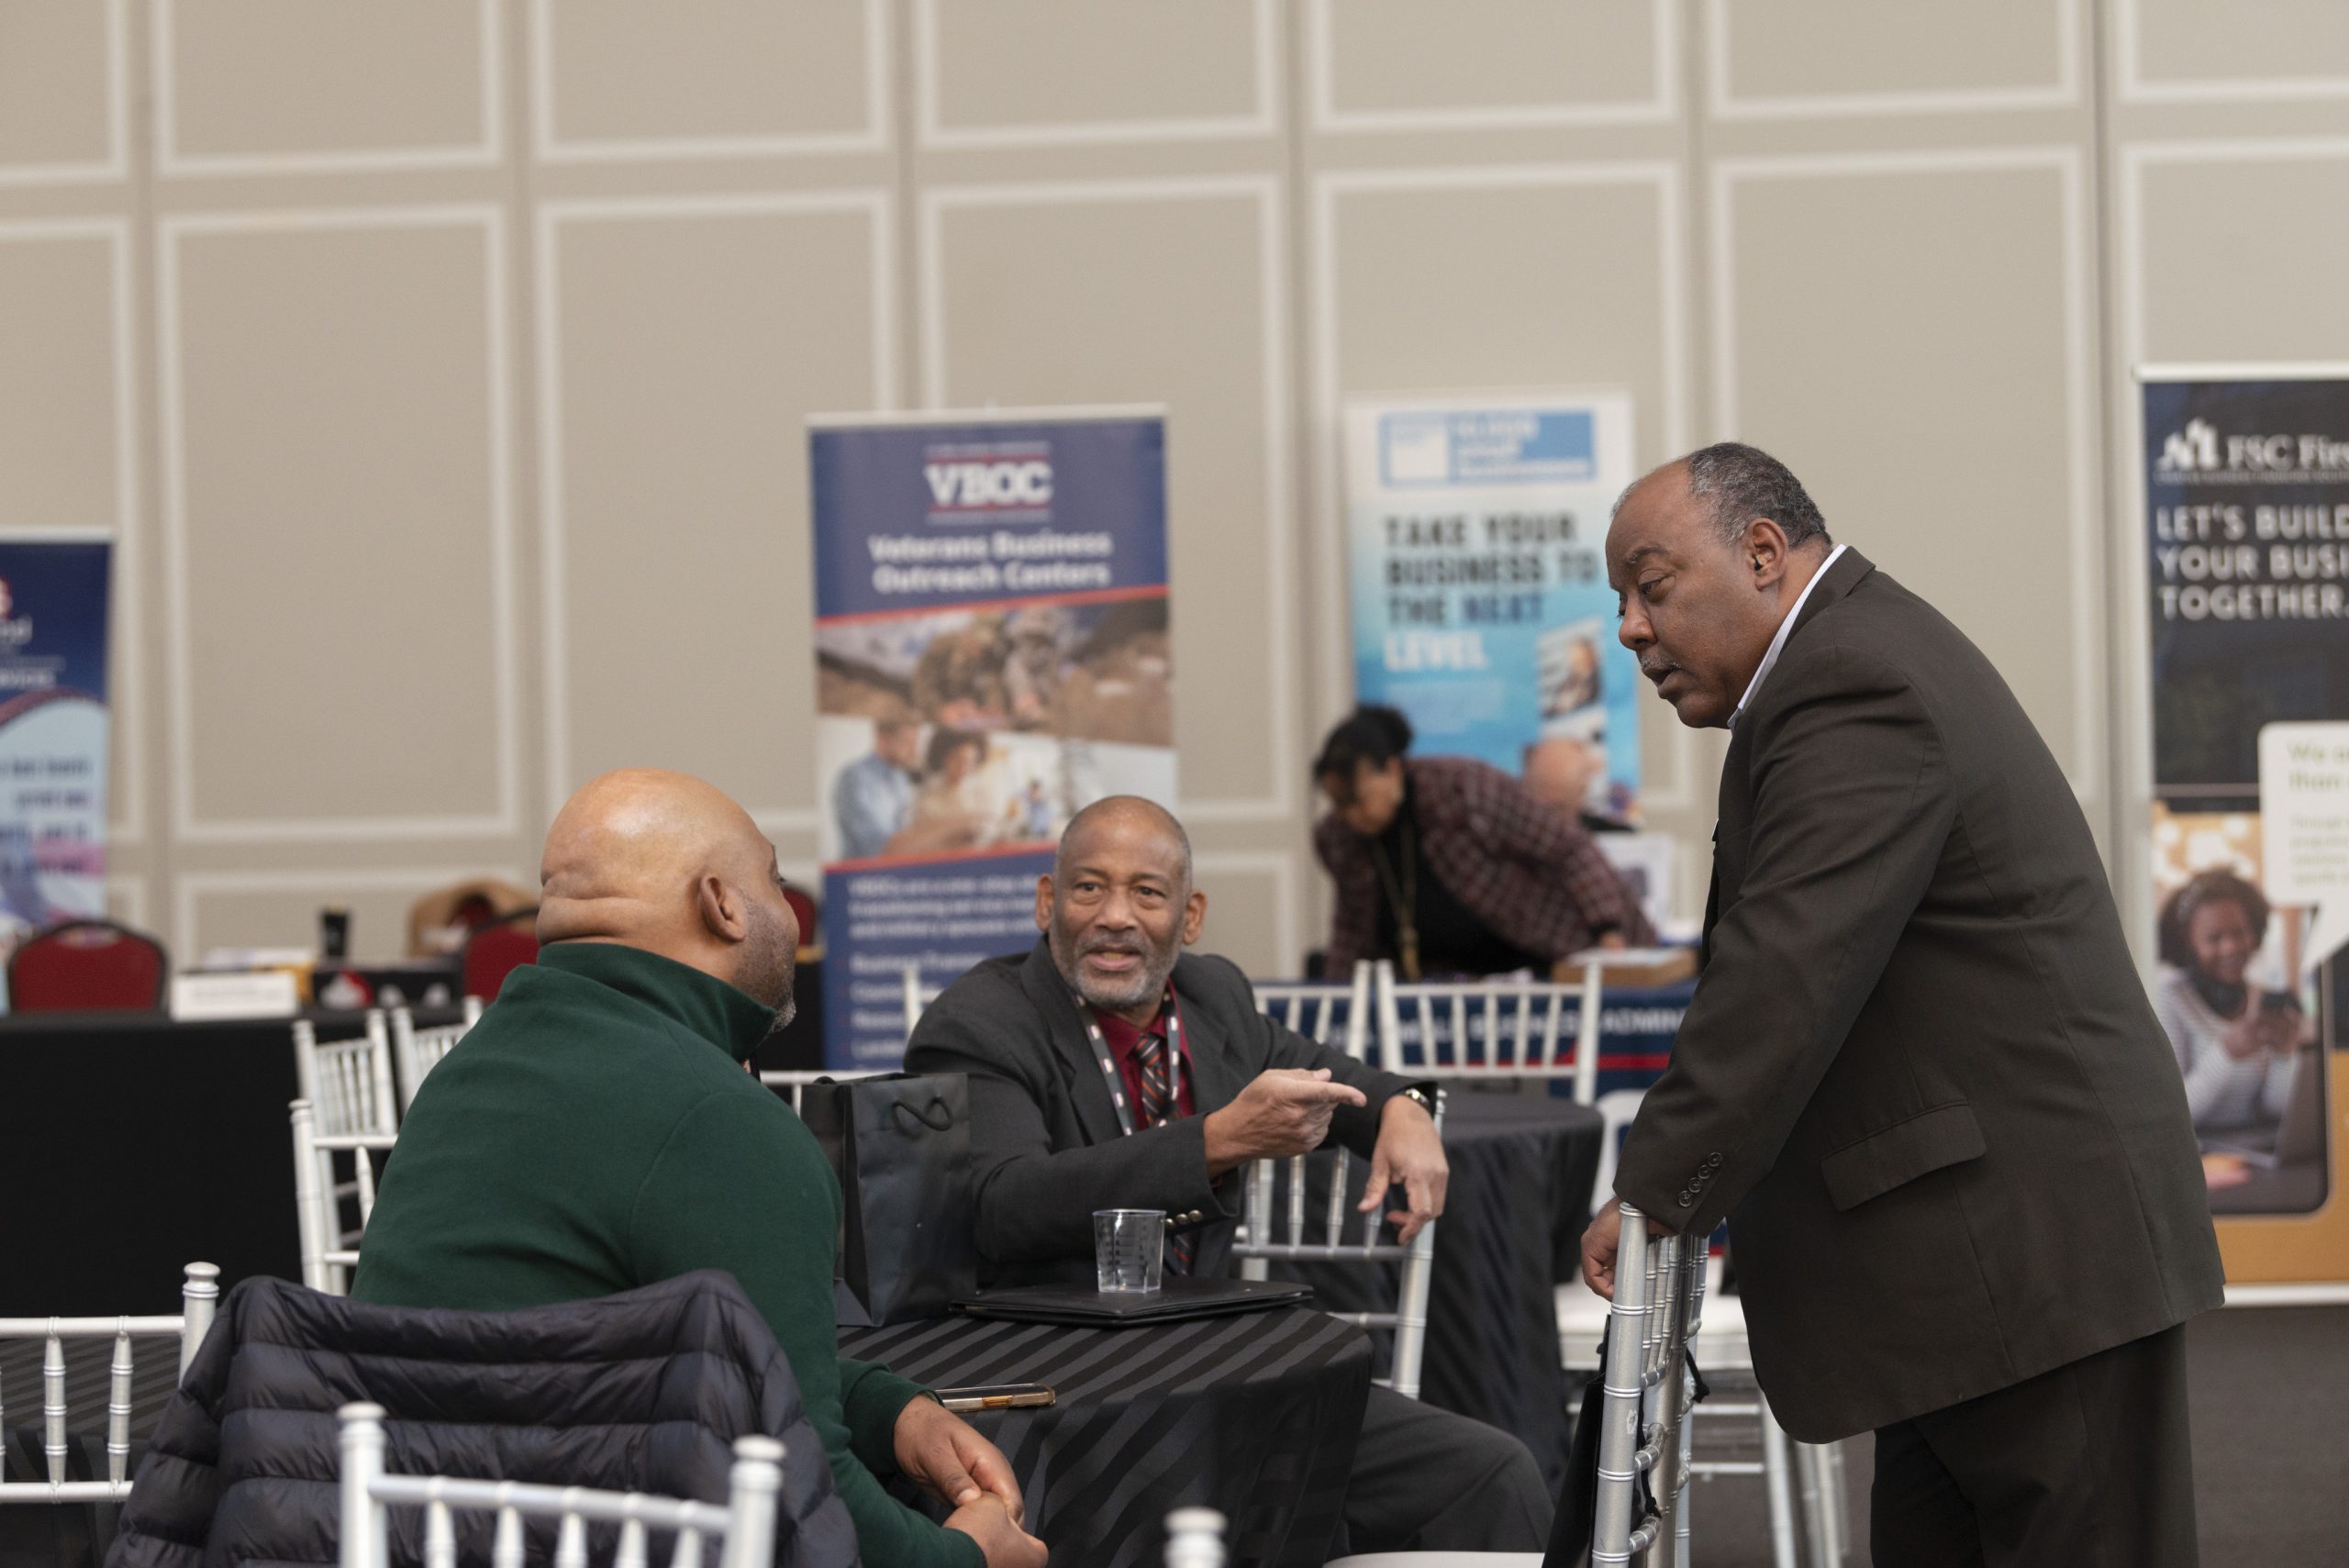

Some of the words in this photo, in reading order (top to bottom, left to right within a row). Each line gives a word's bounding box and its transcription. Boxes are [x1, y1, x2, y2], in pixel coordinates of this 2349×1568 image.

[924, 461, 1052, 506] VBOC
[1386, 516, 1465, 546] TAKE
[1484, 513, 1575, 544] YOUR
[2157, 503, 2246, 540] LET'S
[868, 534, 988, 563] Veterans
[992, 528, 1113, 560] Business
[2157, 544, 2260, 581] YOUR
[873, 561, 1001, 594] Outreach
[1004, 560, 1111, 591] Centers
[1387, 552, 1542, 586] BUSINESS
[1558, 550, 1598, 584] TO
[1388, 595, 1446, 628] THE
[1463, 592, 1542, 625] NEXT
[1385, 630, 1489, 671] LEVEL
